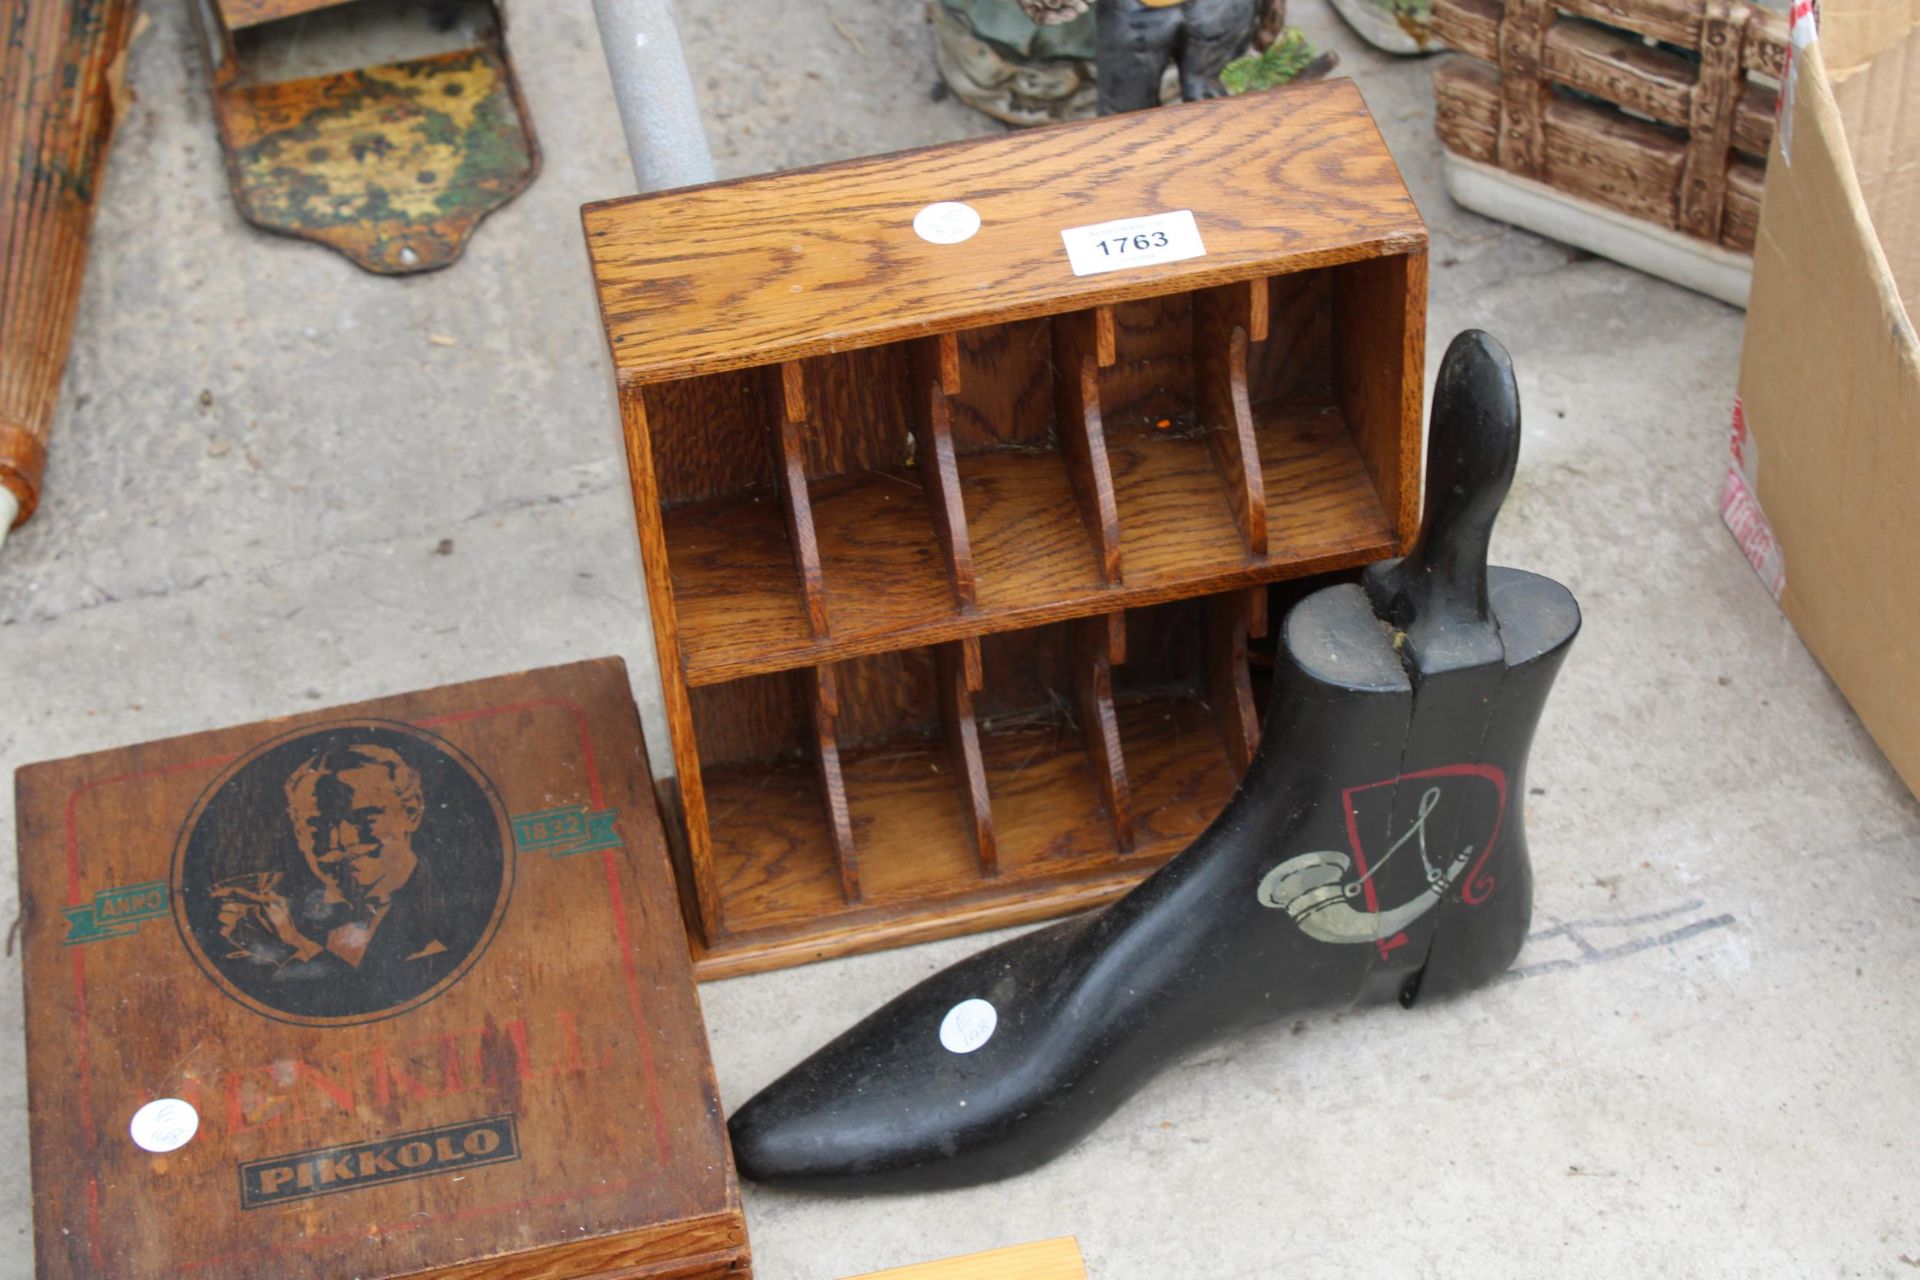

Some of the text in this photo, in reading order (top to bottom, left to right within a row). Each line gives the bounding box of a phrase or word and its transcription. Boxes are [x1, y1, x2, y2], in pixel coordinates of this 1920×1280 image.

[1096, 231, 1169, 256] 1763
[102, 891, 162, 918] ANNO
[259, 1128, 501, 1195] PIKKOLO
